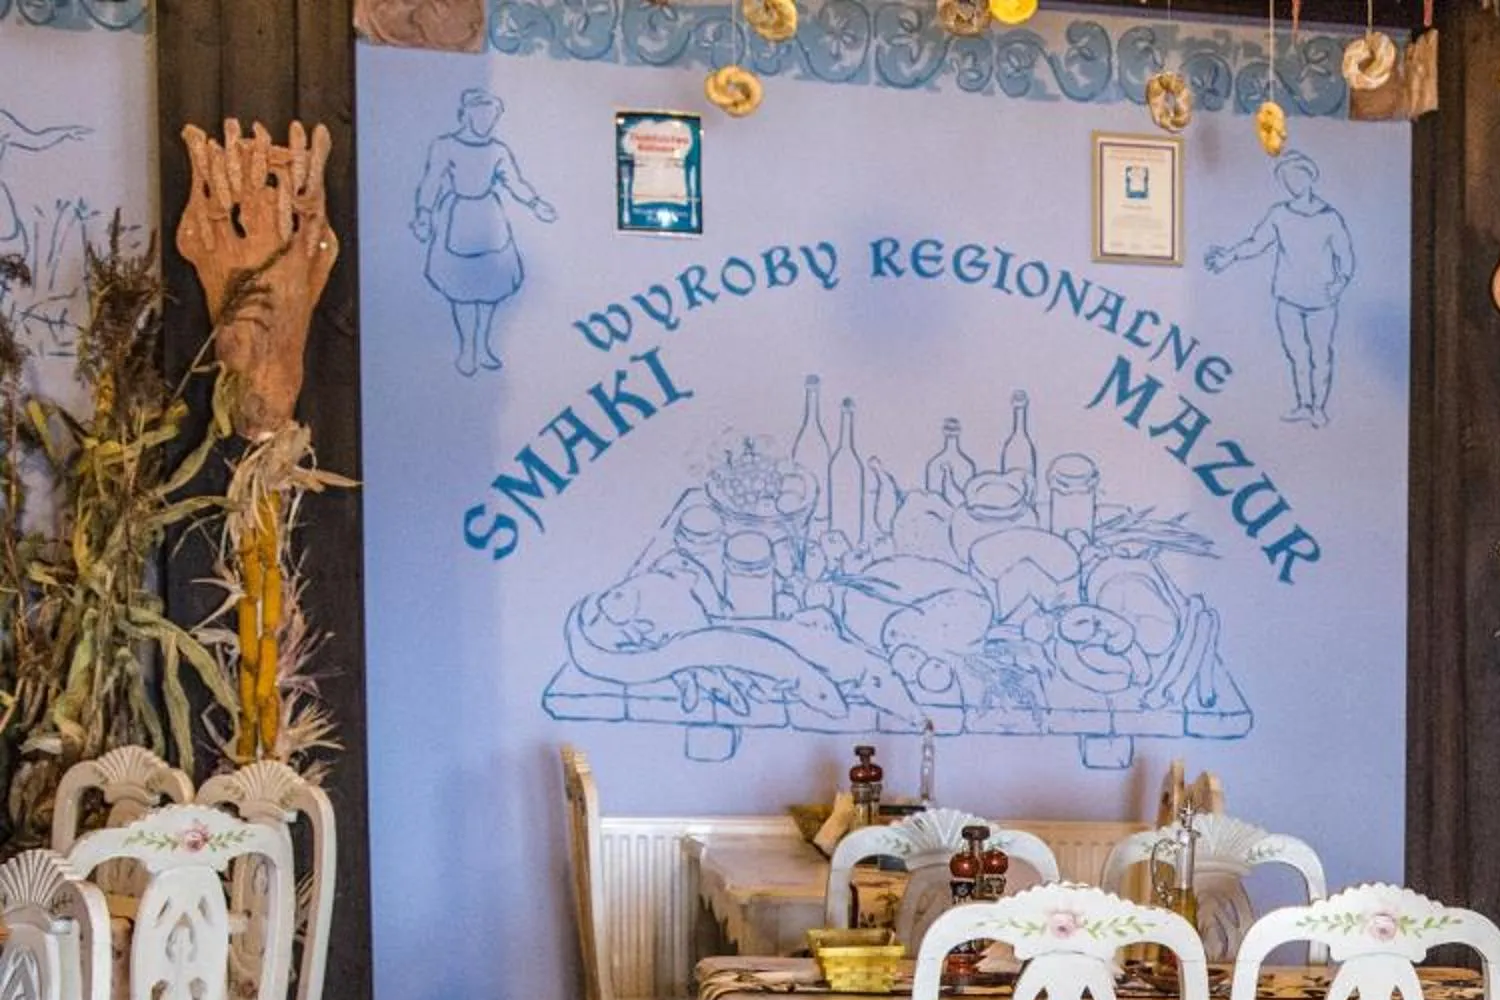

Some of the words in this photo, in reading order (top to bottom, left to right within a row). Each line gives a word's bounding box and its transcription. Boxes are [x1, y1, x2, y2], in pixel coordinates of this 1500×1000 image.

[573, 241, 840, 352] WYROBY
[868, 236, 1234, 394] REGIONALNE
[463, 348, 693, 561] SMAKI
[1085, 354, 1322, 585] MAZUR
